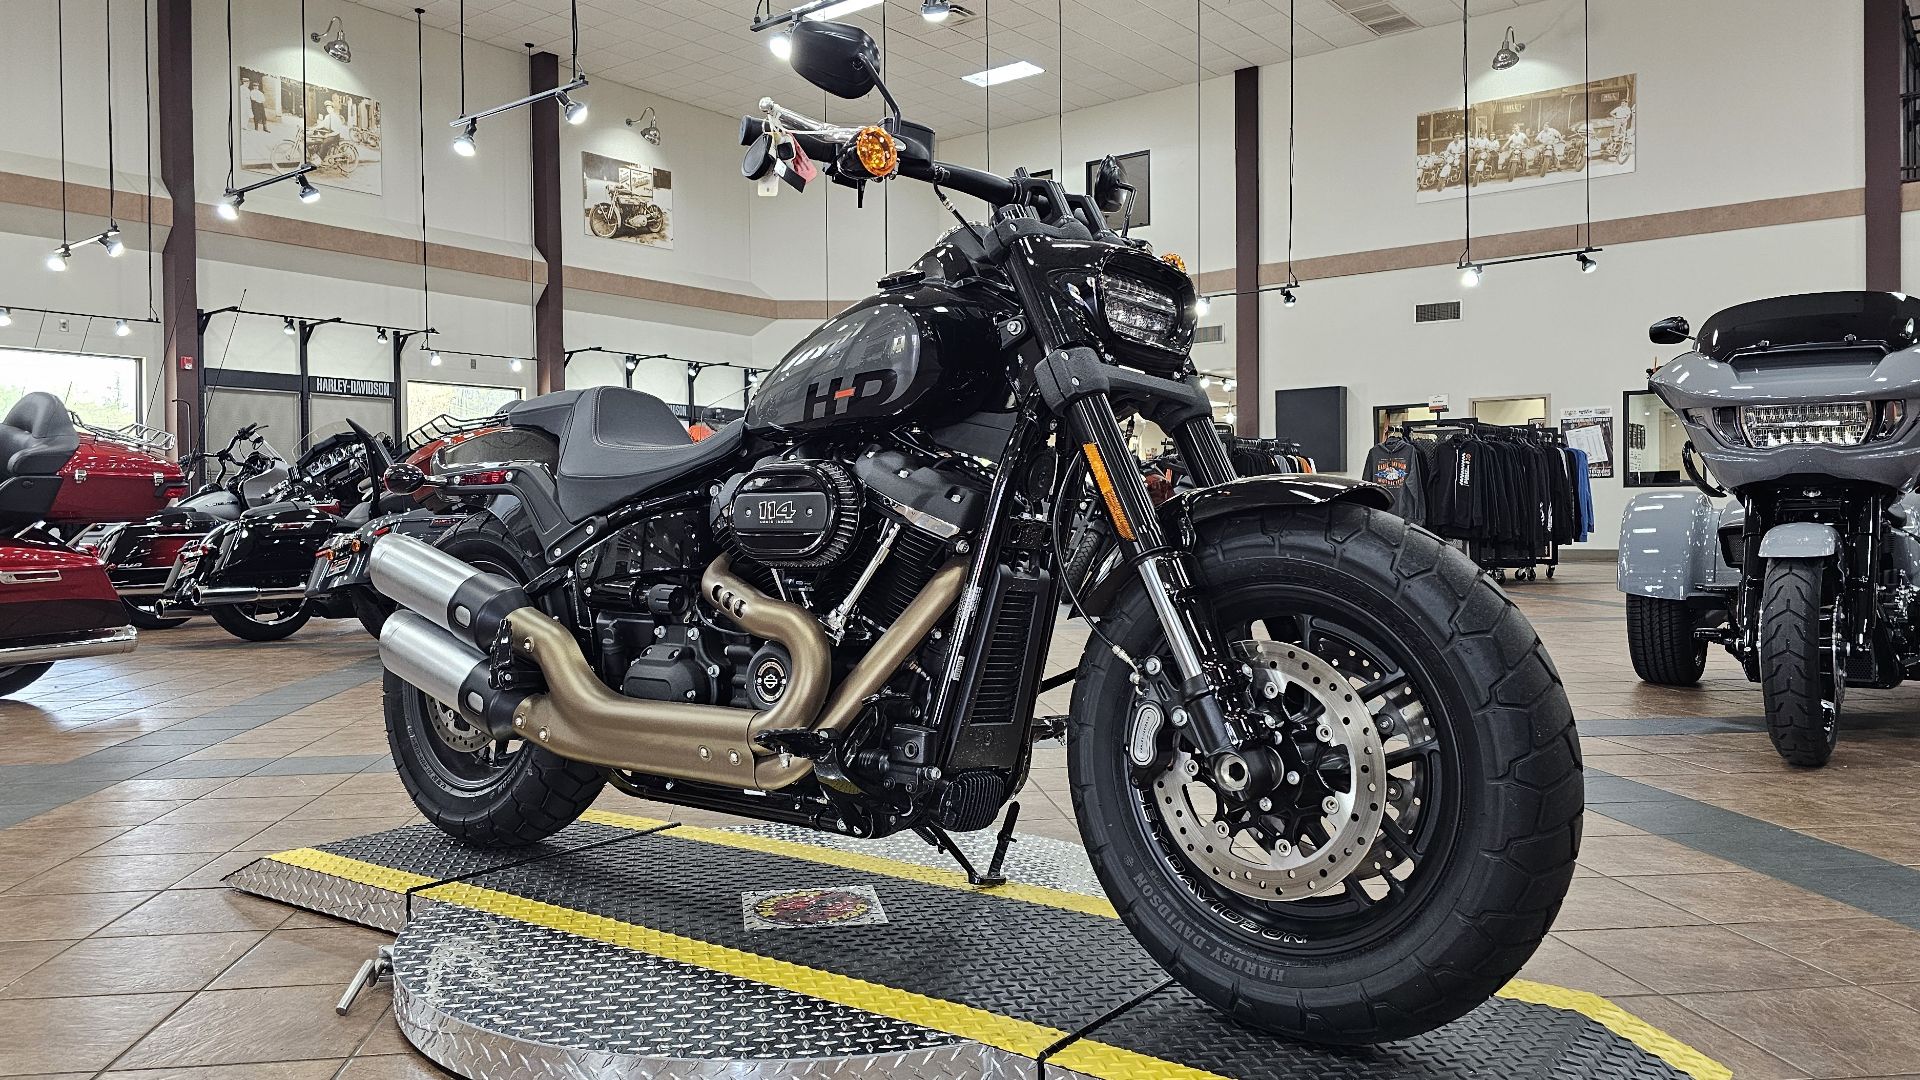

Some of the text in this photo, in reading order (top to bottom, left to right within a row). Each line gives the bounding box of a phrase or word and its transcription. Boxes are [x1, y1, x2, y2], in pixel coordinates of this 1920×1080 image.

[316, 377, 390, 397] HARLEY-DAVIDSON
[802, 368, 898, 421] H-D
[758, 500, 797, 520] 114
[1136, 788, 1306, 944] LEY-DAVIDSON
[1132, 872, 1286, 982] HARLEY-DAVIDSON
